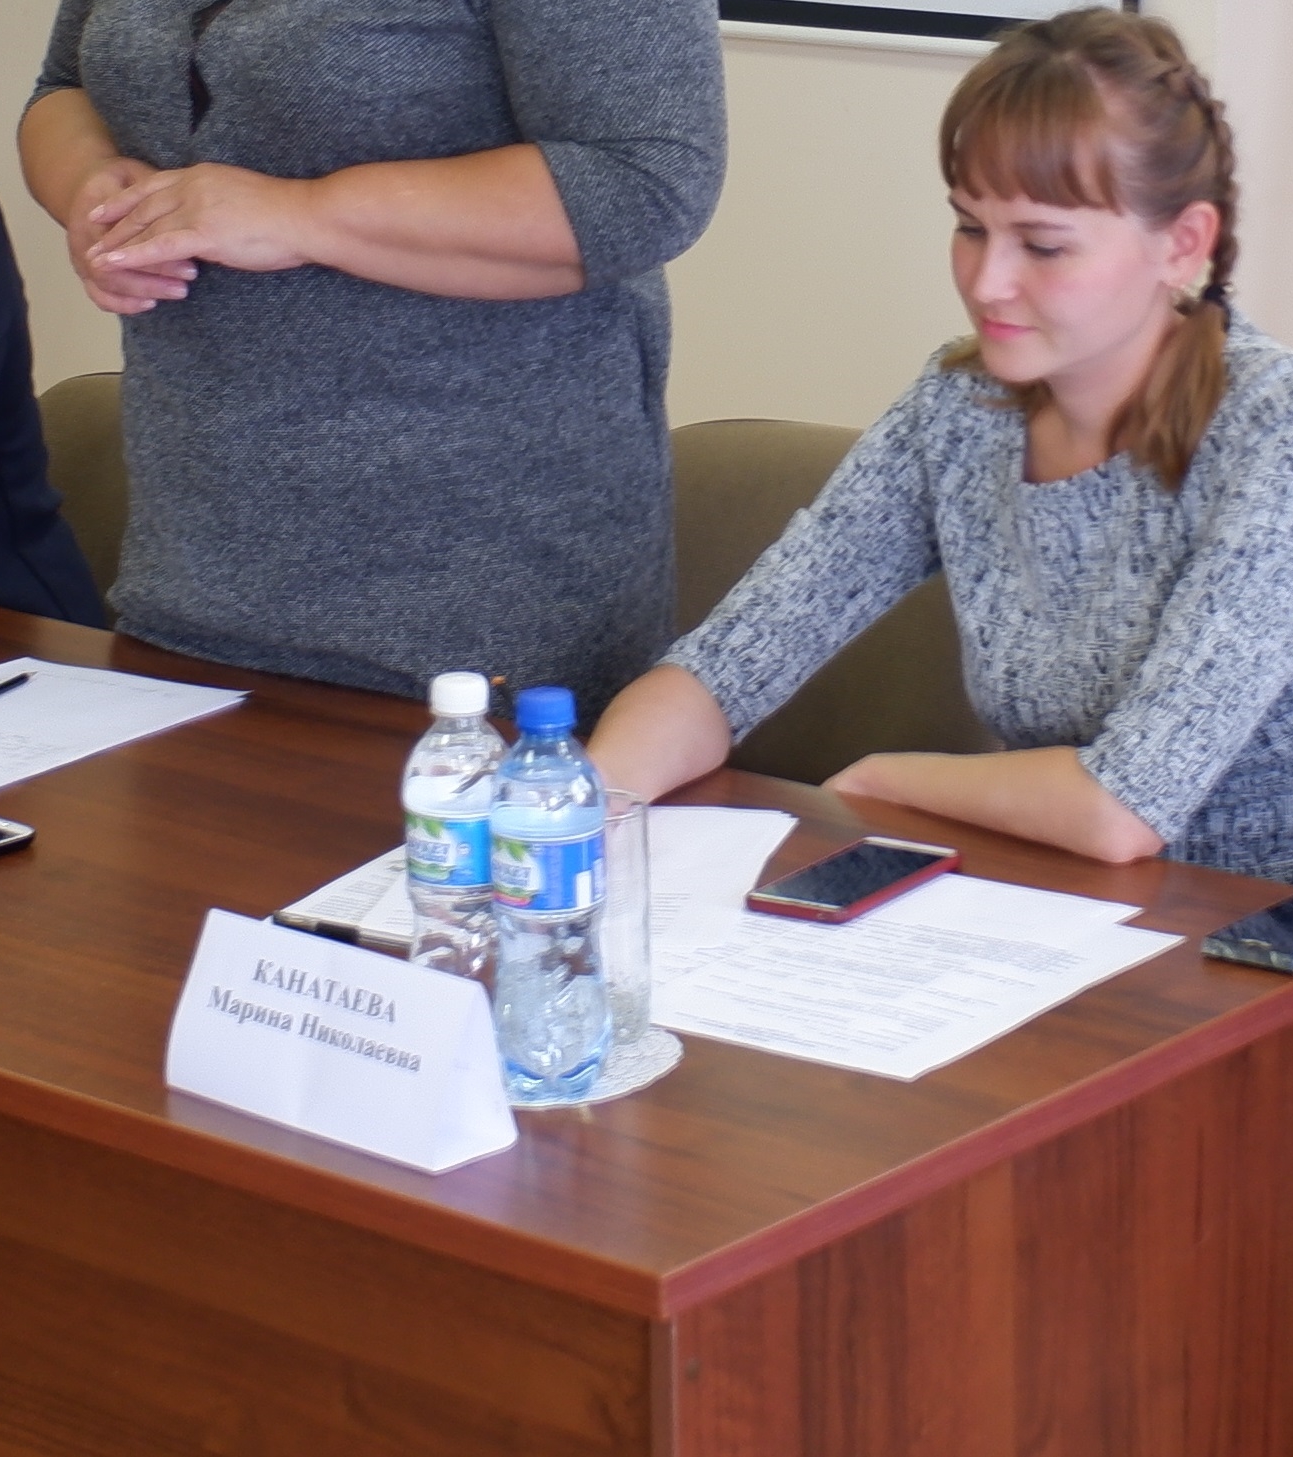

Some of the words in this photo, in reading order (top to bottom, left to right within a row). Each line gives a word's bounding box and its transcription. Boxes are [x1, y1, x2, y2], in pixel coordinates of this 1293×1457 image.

[206, 985, 294, 1033] Марина
[298, 1012, 423, 1073] Николаевна
[252, 959, 396, 1024] КАНАТАЕВА
